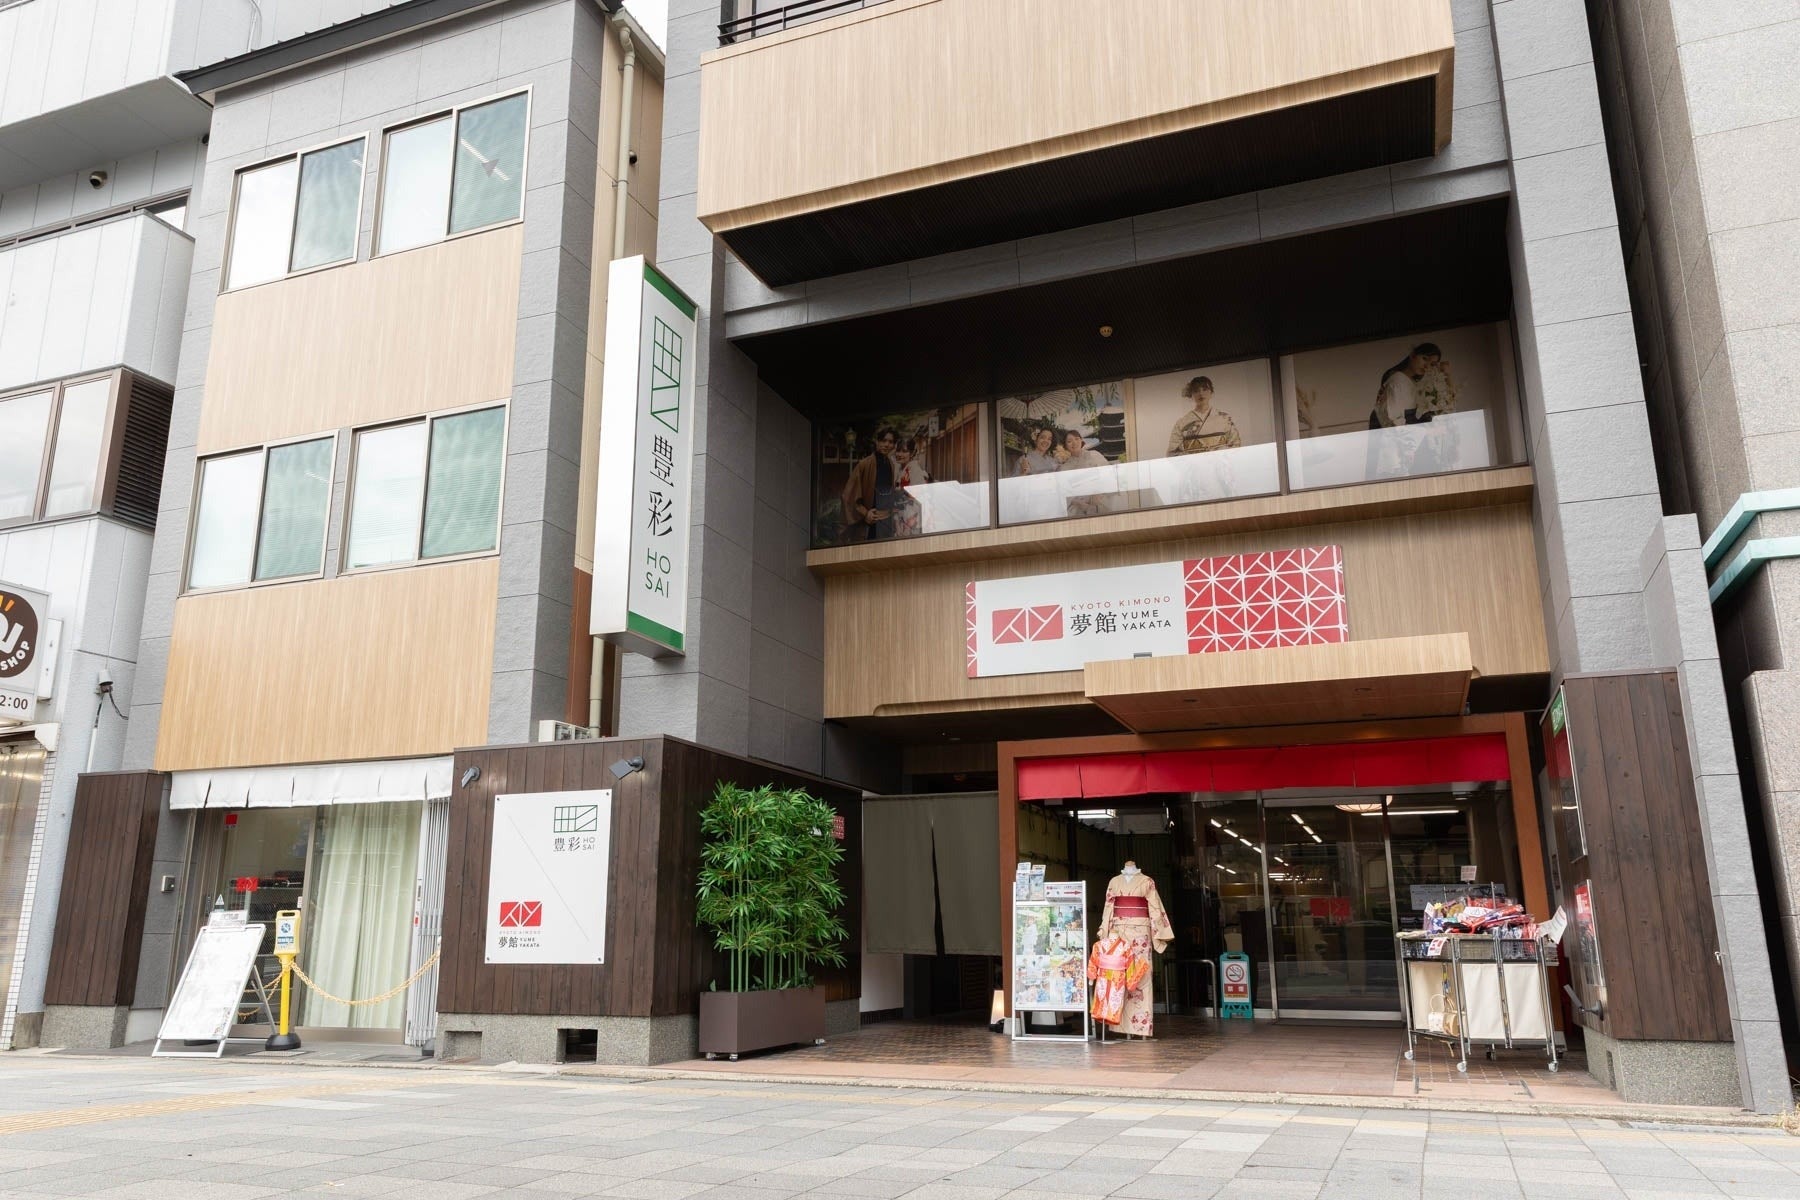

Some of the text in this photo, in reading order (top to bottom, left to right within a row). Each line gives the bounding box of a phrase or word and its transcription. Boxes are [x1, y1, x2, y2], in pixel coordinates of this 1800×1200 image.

[647, 434, 674, 536] 豊彩
[646, 547, 671, 575] HO
[645, 571, 670, 598] SAI
[1071, 596, 1171, 611] KYOTO KIMONO
[1122, 609, 1159, 620] YUME
[1070, 611, 1117, 636] 夢館
[1122, 619, 1172, 631] YAKATA
[0, 640, 30, 671] SHOP
[582, 836, 596, 844] HO
